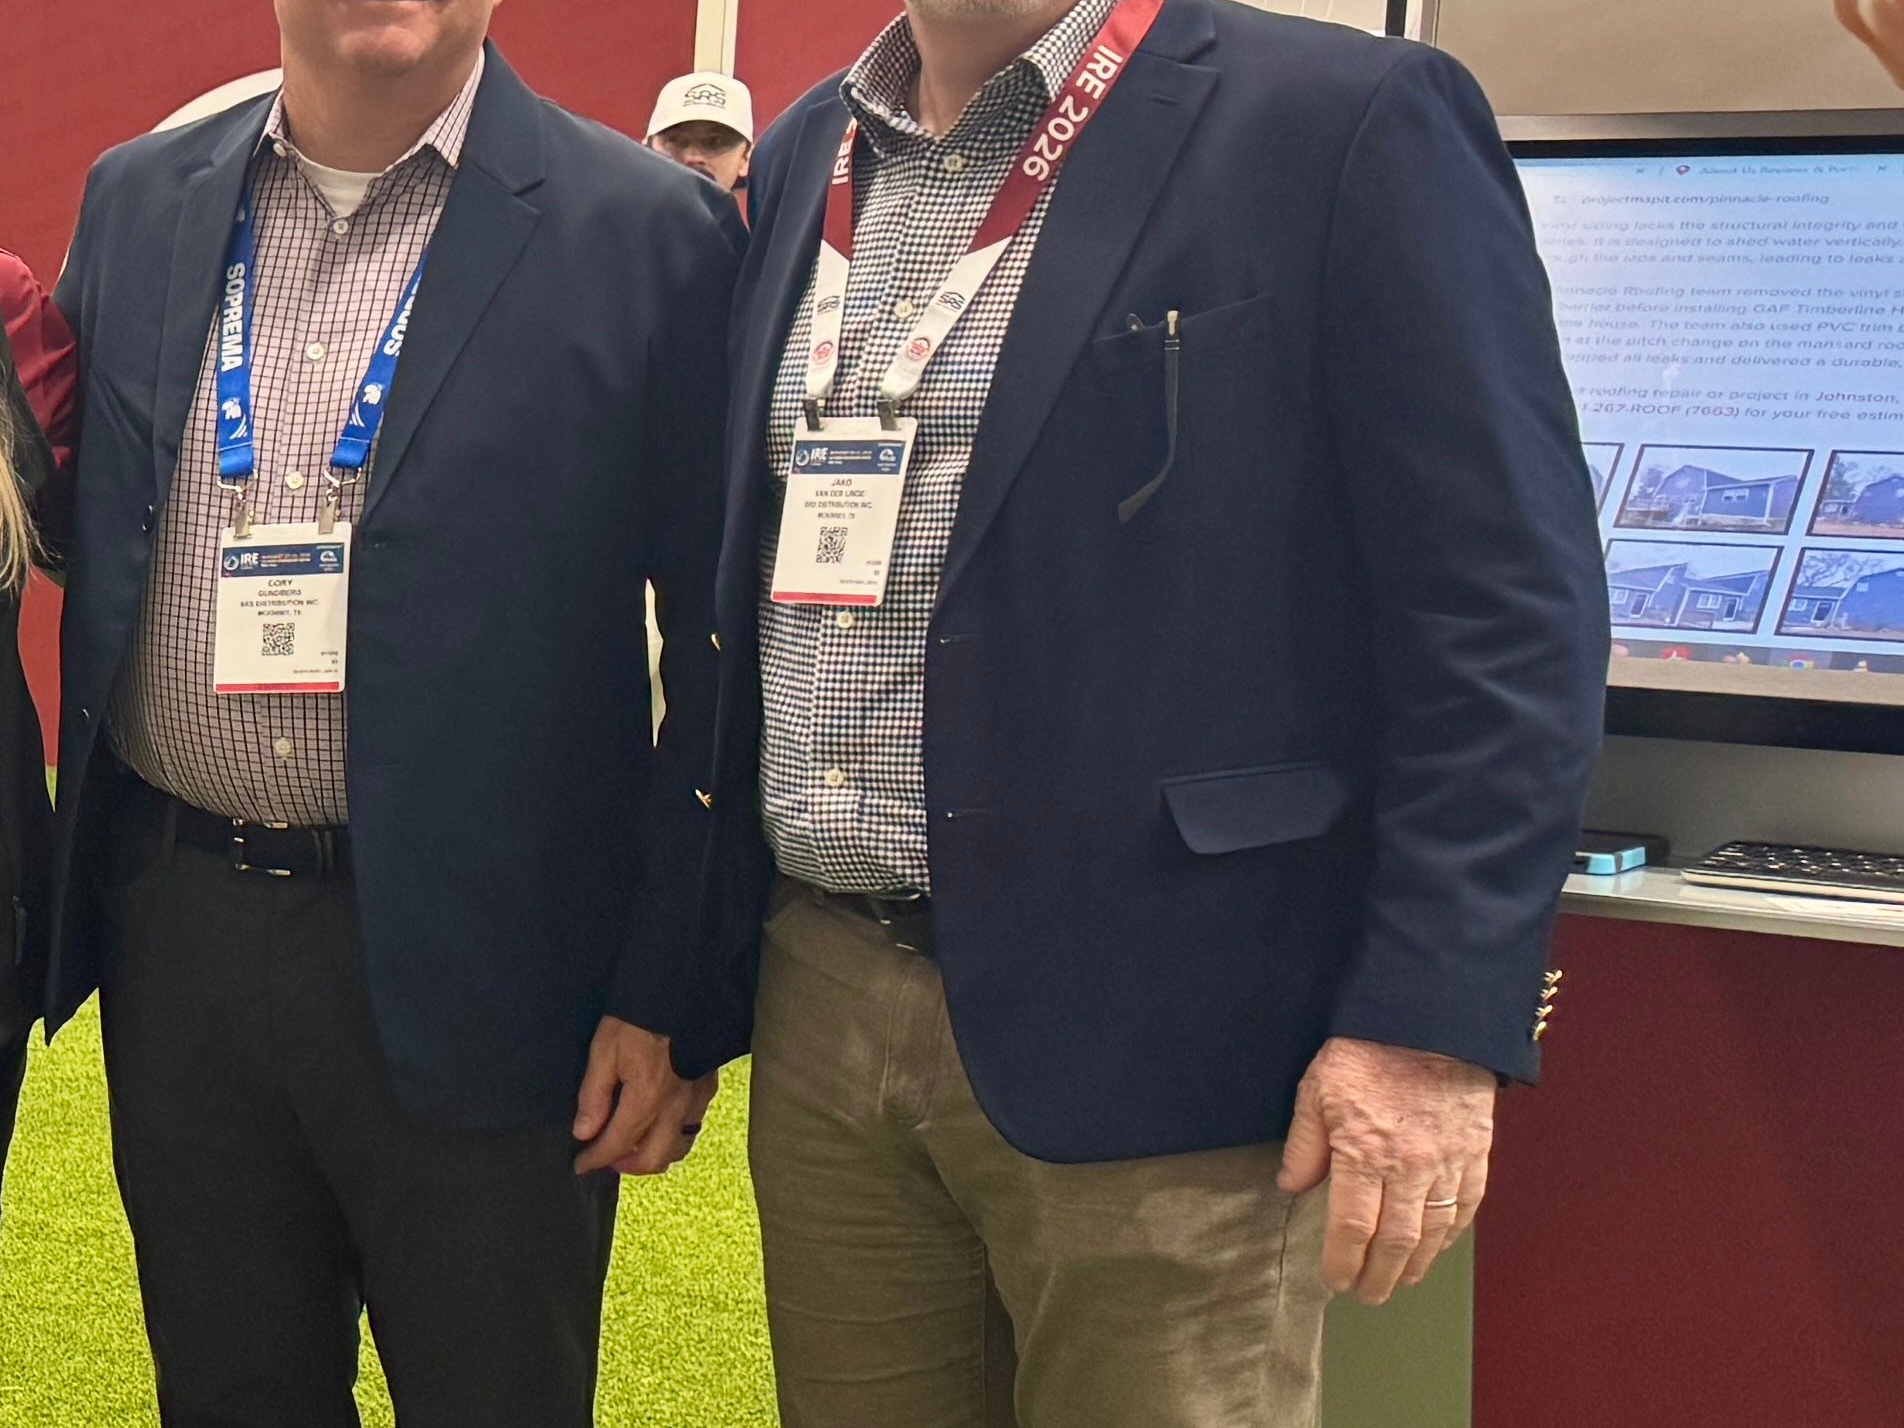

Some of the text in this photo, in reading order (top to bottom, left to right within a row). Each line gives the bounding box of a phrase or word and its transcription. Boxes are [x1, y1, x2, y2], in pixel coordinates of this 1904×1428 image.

[684, 89, 726, 105] SRS
[1023, 45, 1124, 182] IRE 2026
[1792, 220, 1861, 232] integrity
[1737, 287, 1812, 298] removed
[1797, 304, 1886, 316] Timberline
[222, 261, 245, 372] SOPREMA
[241, 552, 259, 565] IRE
[268, 579, 293, 587] CORY
